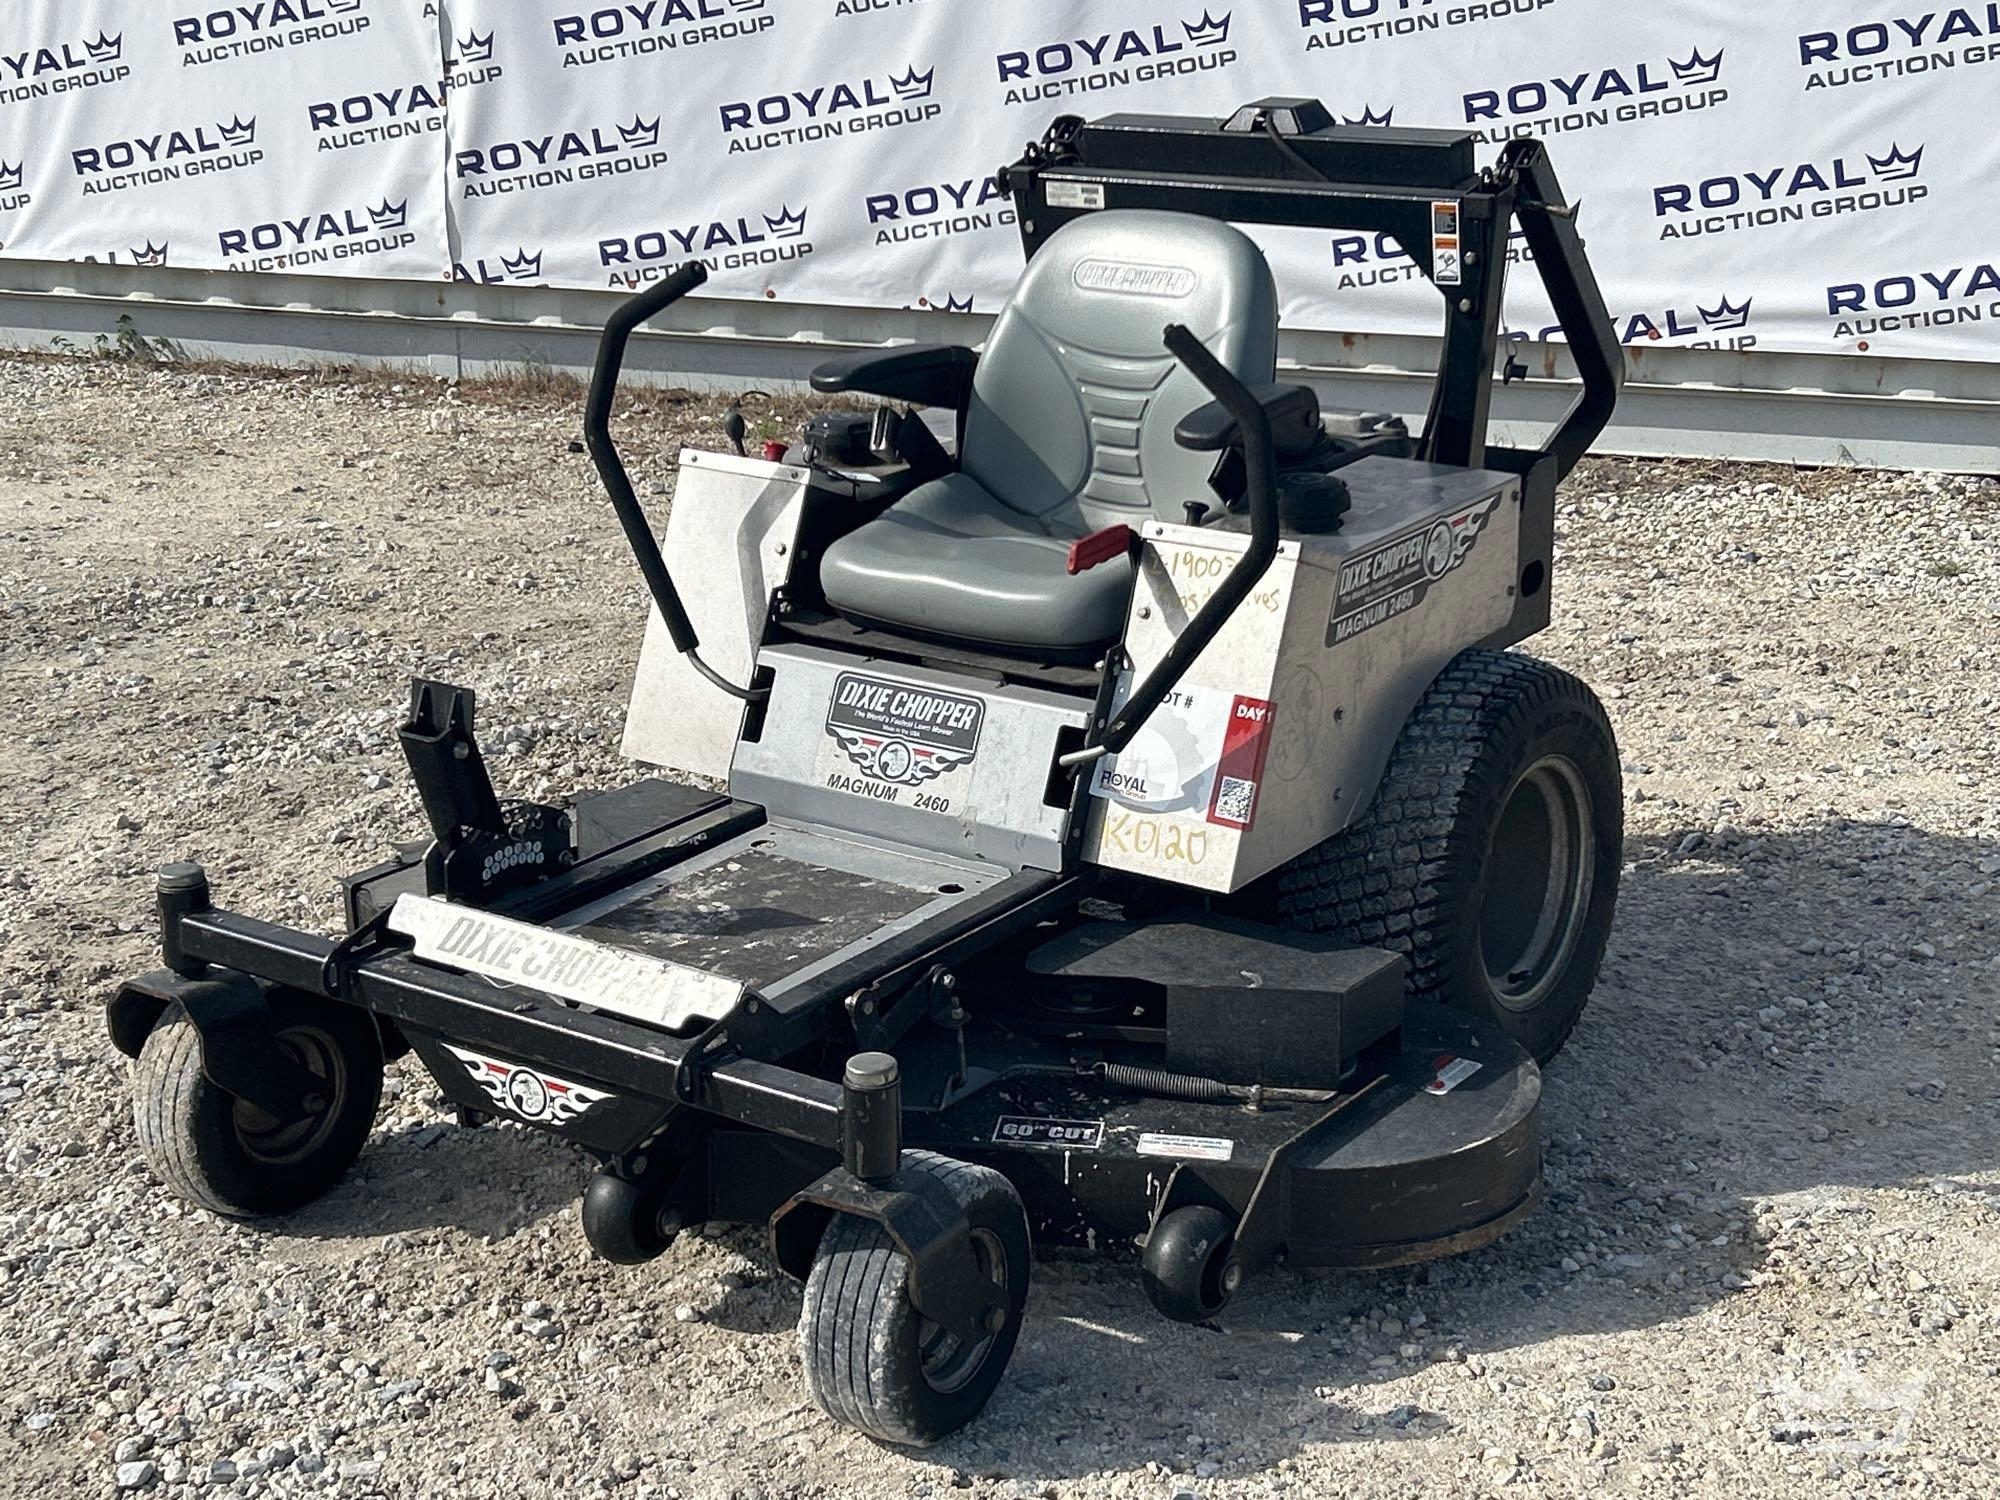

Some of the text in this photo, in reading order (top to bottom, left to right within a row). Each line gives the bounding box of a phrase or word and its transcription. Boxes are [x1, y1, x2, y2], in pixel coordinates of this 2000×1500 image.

[173, 0, 325, 46] ROYAL
[182, 16, 371, 67] AUCTION GROUP
[553, 0, 725, 46] ROYAL
[562, 15, 776, 69] AUCTION GROUP
[1305, 12, 1439, 51] AUCTION
[1799, 3, 2000, 66] ROYAL
[0, 44, 86, 80] YAL
[997, 25, 1183, 83] ROYAL
[1805, 51, 1956, 91] AUCTION
[0, 65, 131, 104] TION GROUP
[1004, 50, 1238, 106] AUCTION GROUP
[1463, 63, 1669, 123] ROYAL
[719, 79, 890, 132] ROYAL
[728, 103, 942, 155] AUCTION GROUP
[1470, 88, 1729, 145] AUCTION GROUP
[72, 127, 221, 175] ROYAL
[317, 121, 421, 152] AUCTION
[456, 129, 620, 179] ROYAL
[82, 149, 265, 196] AUCTION GROUP
[463, 152, 668, 199] AUCTION GROUP
[1653, 158, 1867, 217] ROYAL
[866, 176, 1006, 224] ROYA
[1659, 185, 1929, 241] AUCTION GROUP
[219, 210, 369, 257] ROYAL
[228, 232, 417, 273] AUCTION GROUP
[598, 218, 765, 266] ROYAL
[875, 213, 992, 246] AUCTION
[608, 243, 814, 288] AUCTN GROUP
[1337, 264, 1426, 291] AUCT
[1827, 264, 2000, 315] ROYA
[1833, 305, 1982, 338] AUCTION
[1339, 560, 1372, 596] DIXIE
[1371, 534, 1424, 581] CHOPPER
[1335, 590, 1415, 642] MAGNUM 2460
[838, 680, 977, 731] DIXIE CHOPPER
[1162, 692, 1182, 707] OT
[1236, 704, 1267, 722] DAY
[826, 773, 950, 814] MAGNUM 2460
[1100, 770, 1148, 794] ROYAL
[437, 916, 530, 971] DIXIE
[1047, 1126, 1096, 1141] CUT
